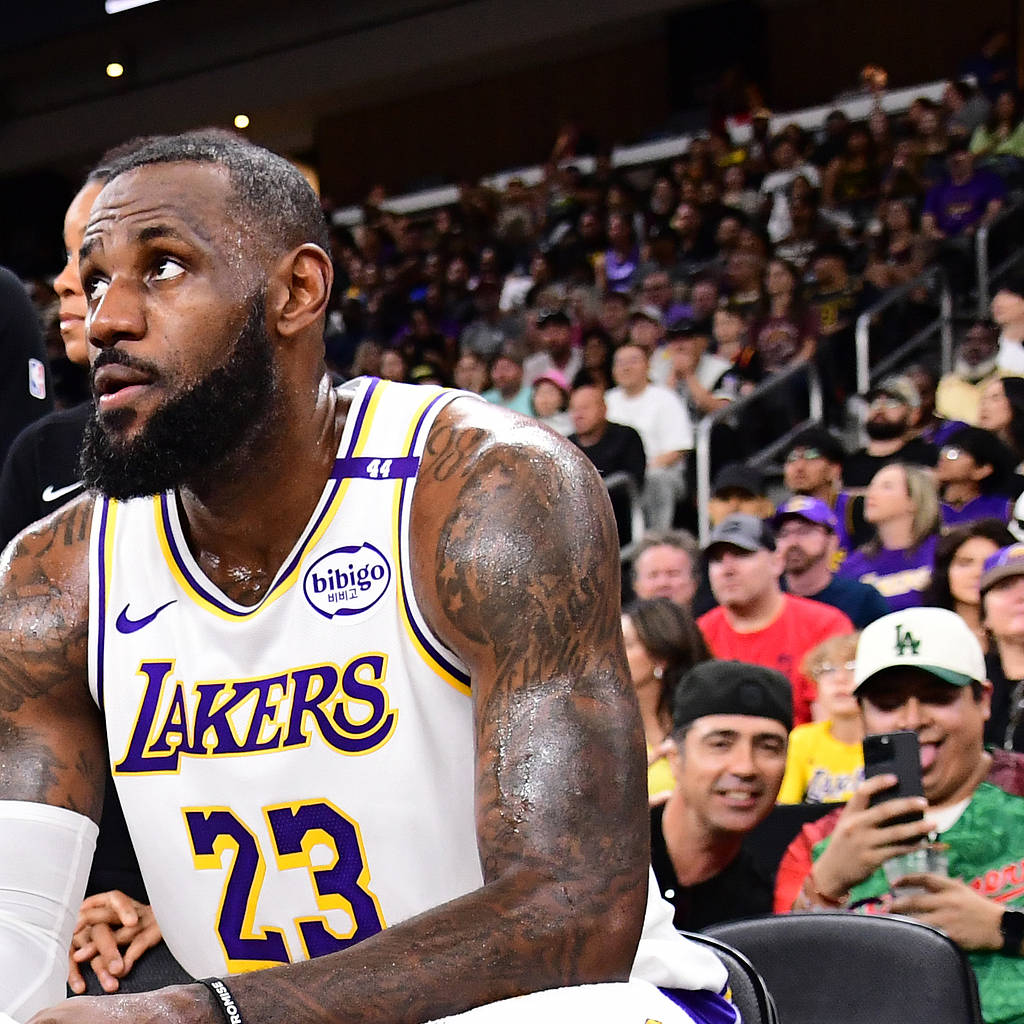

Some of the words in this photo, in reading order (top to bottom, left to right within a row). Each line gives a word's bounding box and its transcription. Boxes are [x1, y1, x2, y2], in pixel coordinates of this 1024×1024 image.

[366, 459, 393, 478] 44
[311, 564, 386, 594] bibigo
[327, 588, 359, 603] 비비고
[895, 624, 920, 656] LA
[112, 651, 399, 776] LAKERS
[180, 797, 388, 970] 23
